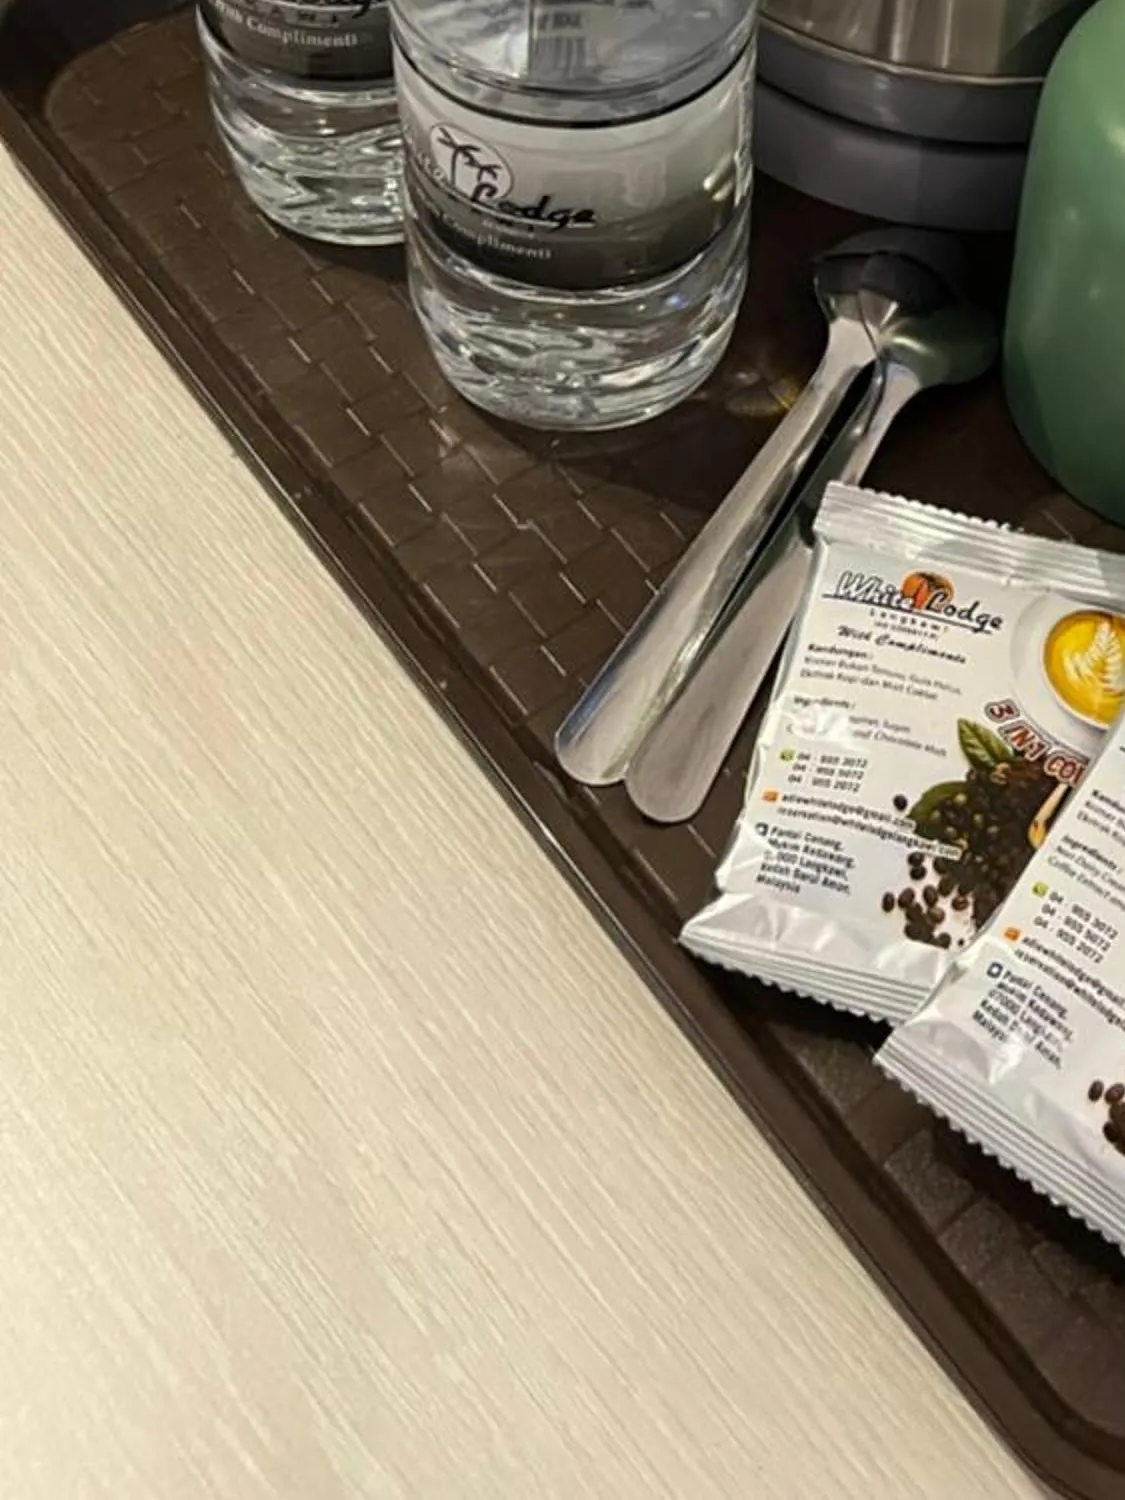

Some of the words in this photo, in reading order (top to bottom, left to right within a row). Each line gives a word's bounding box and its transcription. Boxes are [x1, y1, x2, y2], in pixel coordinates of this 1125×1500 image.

[470, 183, 597, 232] Lodge
[922, 589, 1005, 637] Lodge
[986, 700, 1018, 721] 3
